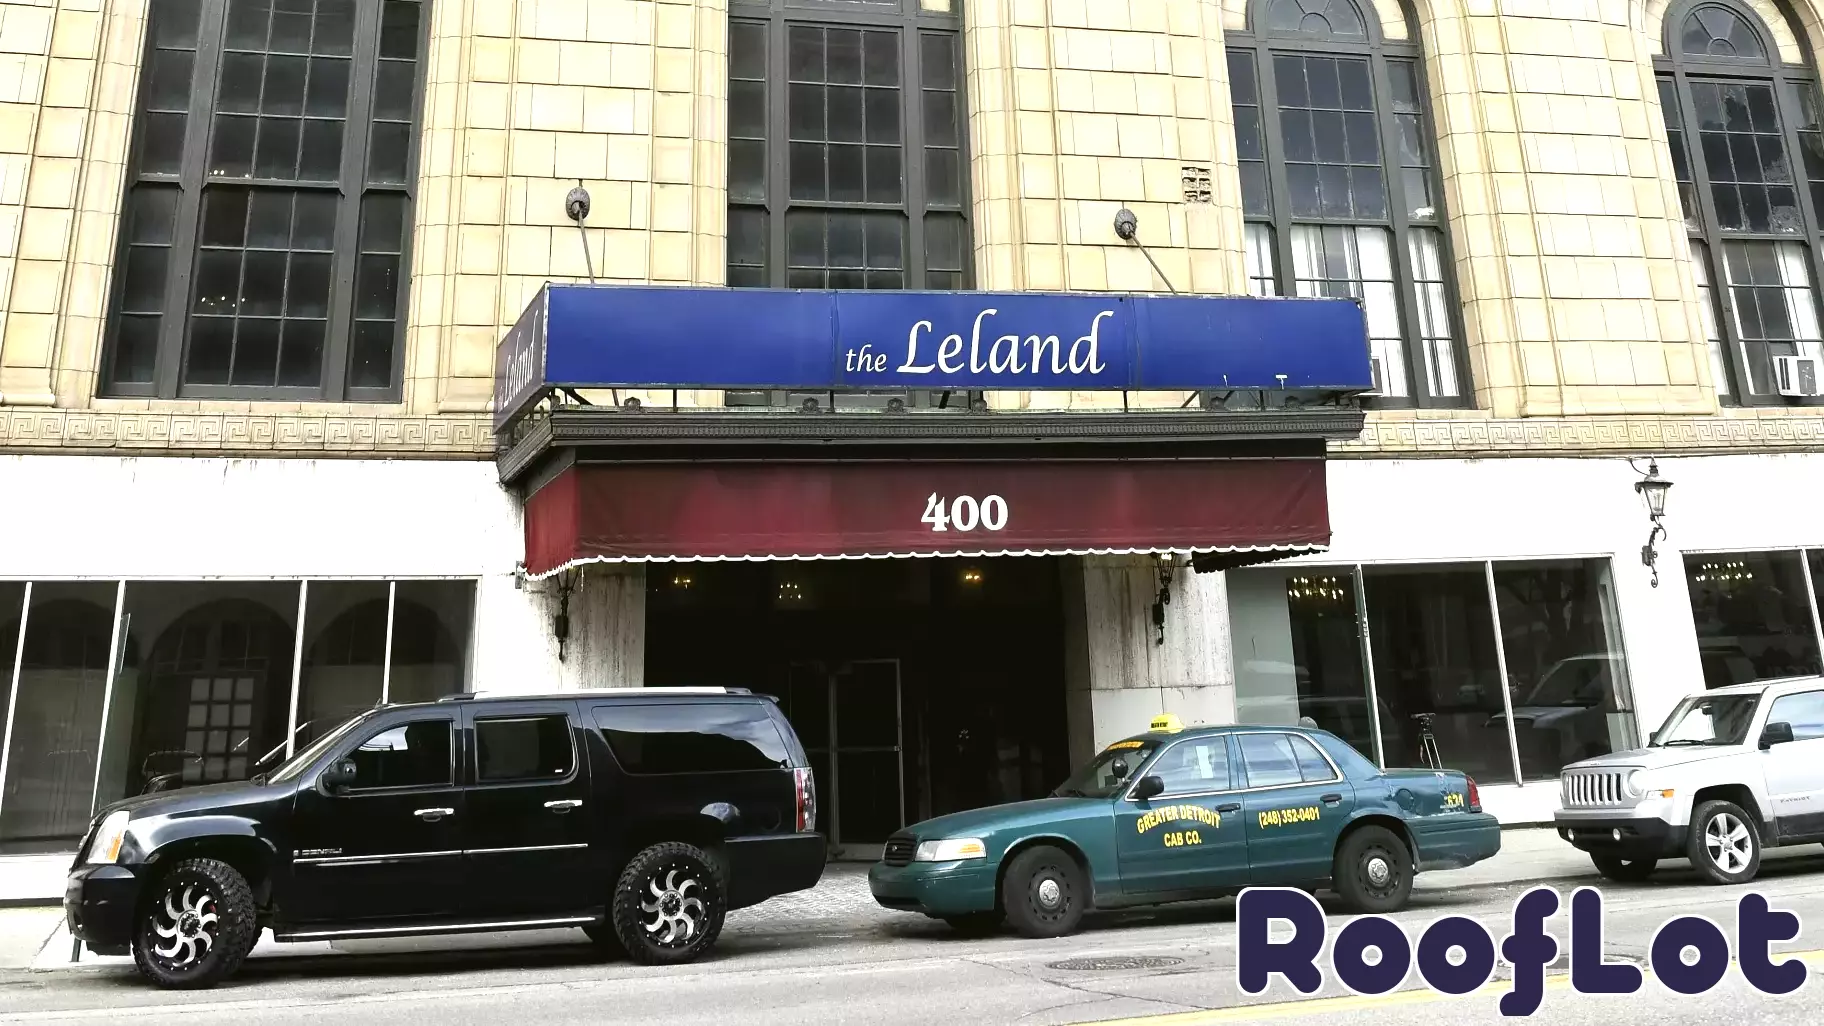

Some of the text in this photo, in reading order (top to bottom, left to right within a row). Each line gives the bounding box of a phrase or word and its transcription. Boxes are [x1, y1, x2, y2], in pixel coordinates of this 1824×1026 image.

[845, 308, 1114, 374] the Leland
[504, 309, 539, 409] Leland
[920, 491, 1009, 532] 400
[1137, 804, 1221, 834] GREATER DETROIT
[1258, 806, 1320, 830] (248) 352-0401
[1164, 830, 1202, 847] CAB CO.
